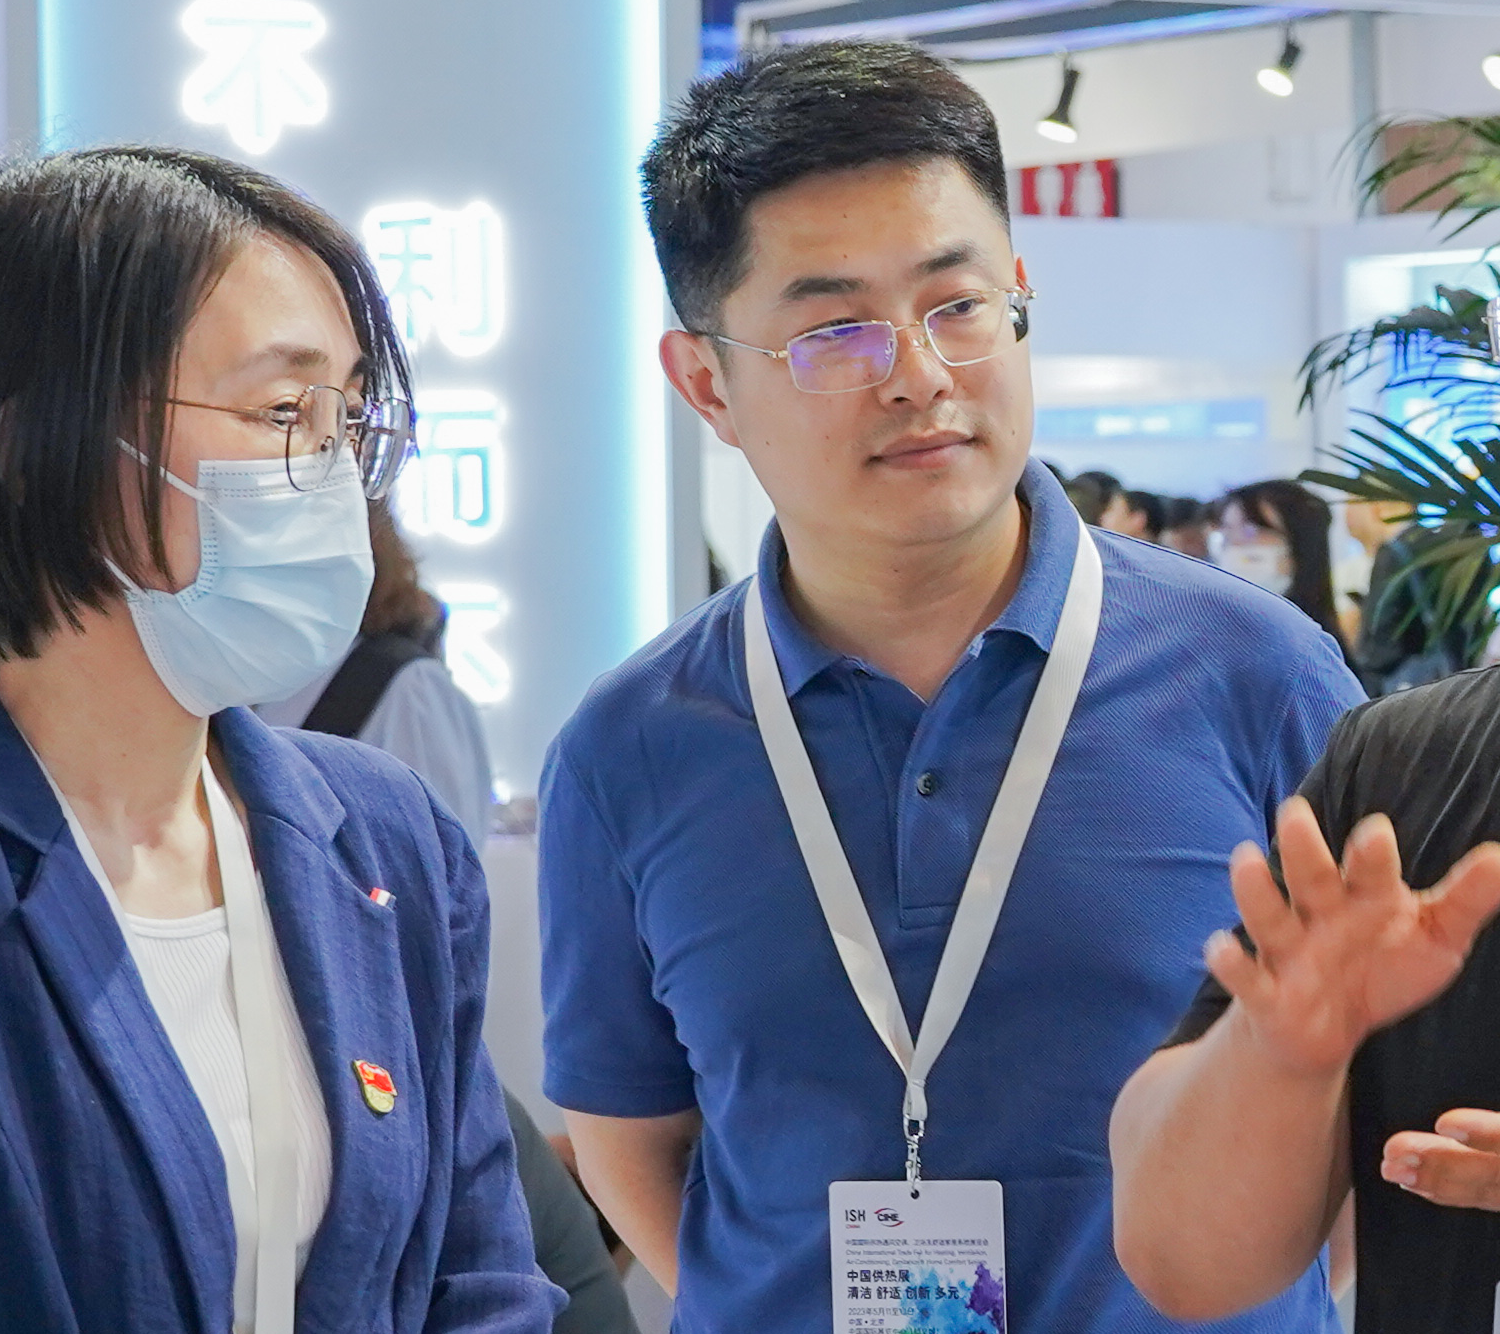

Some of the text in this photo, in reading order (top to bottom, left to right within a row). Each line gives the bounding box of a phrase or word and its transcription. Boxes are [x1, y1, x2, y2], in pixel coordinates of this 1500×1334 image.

[845, 1209, 866, 1222] ISH
[847, 1269, 910, 1283] 中国供热展
[847, 1286, 960, 1299] 清洁 舒适 创新 多元
